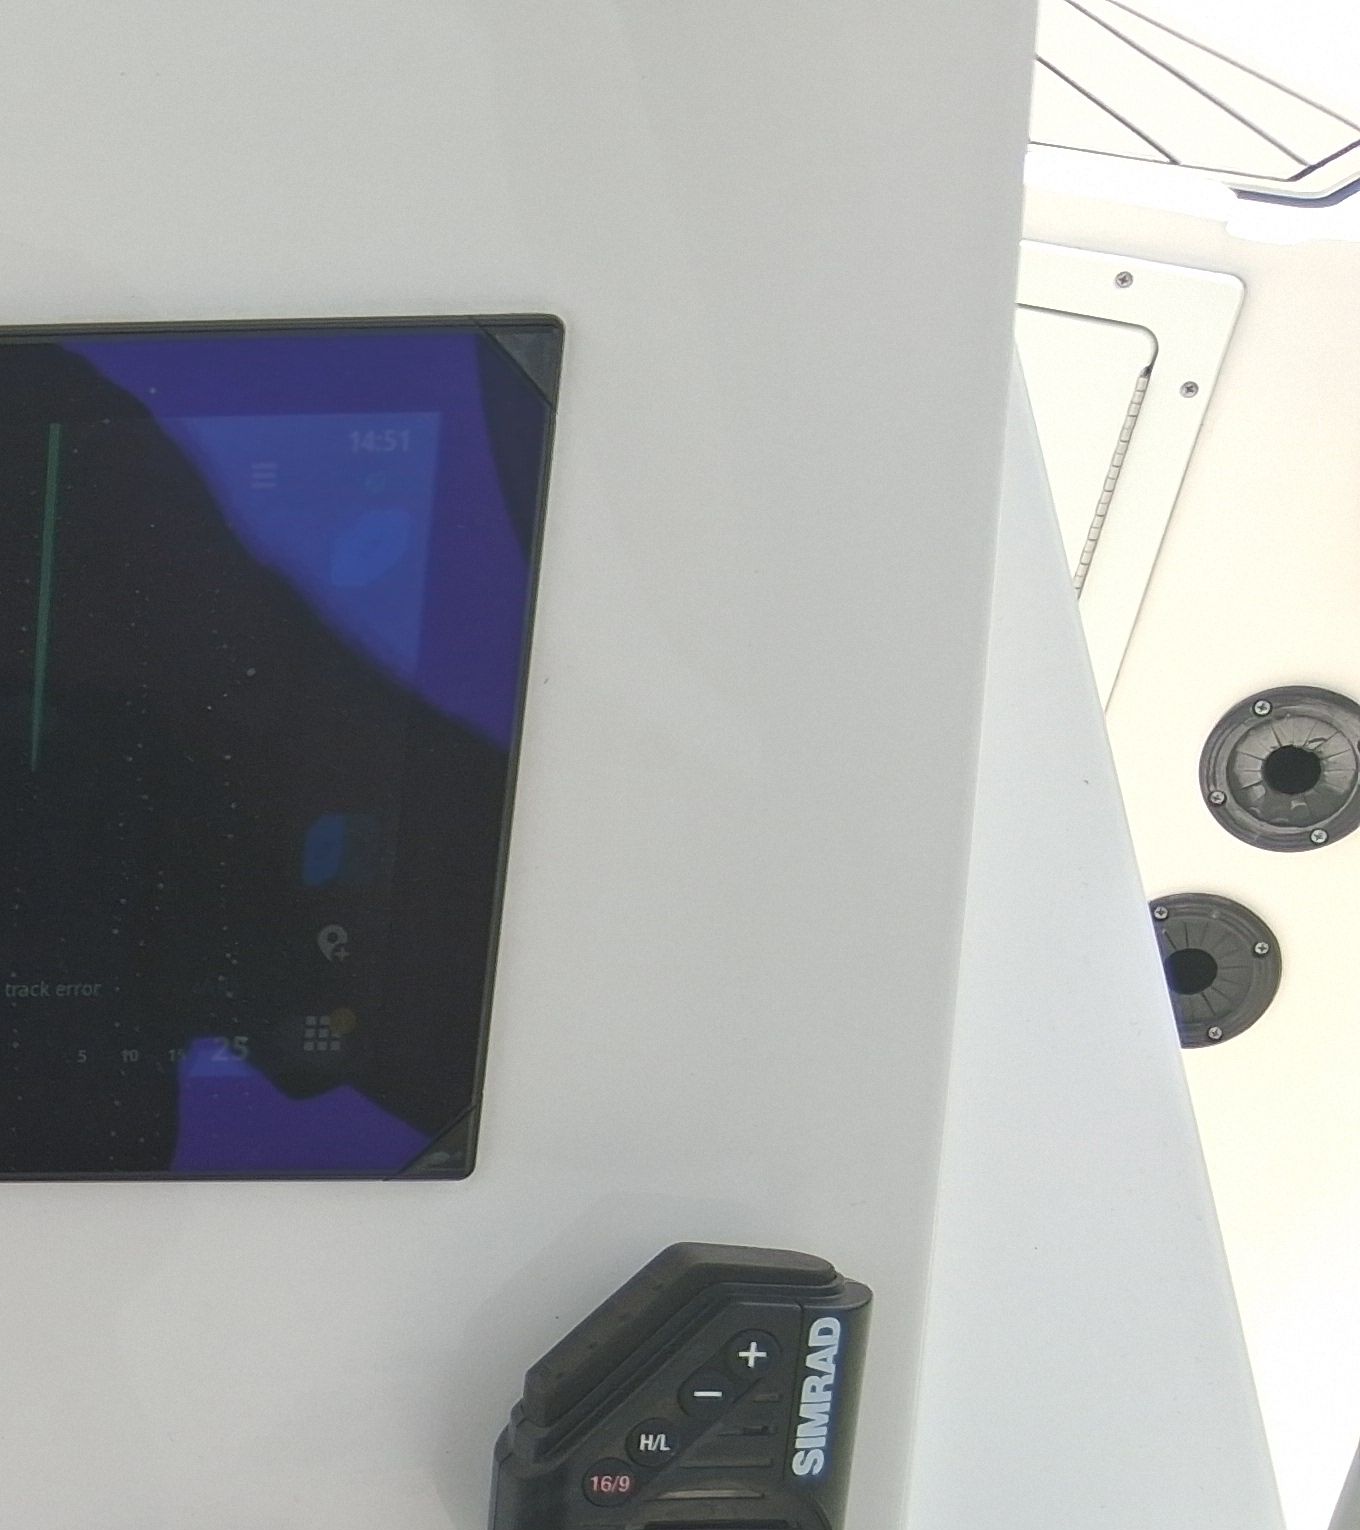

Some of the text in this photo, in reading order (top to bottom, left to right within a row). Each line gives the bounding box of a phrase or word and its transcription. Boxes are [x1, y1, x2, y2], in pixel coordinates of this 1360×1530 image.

[349, 429, 411, 454] 14:51
[5, 980, 50, 998] track
[55, 982, 101, 997] error
[791, 1316, 841, 1476] SIMRAD
[638, 1433, 672, 1453] H/L
[589, 1474, 631, 1494] 16/9
